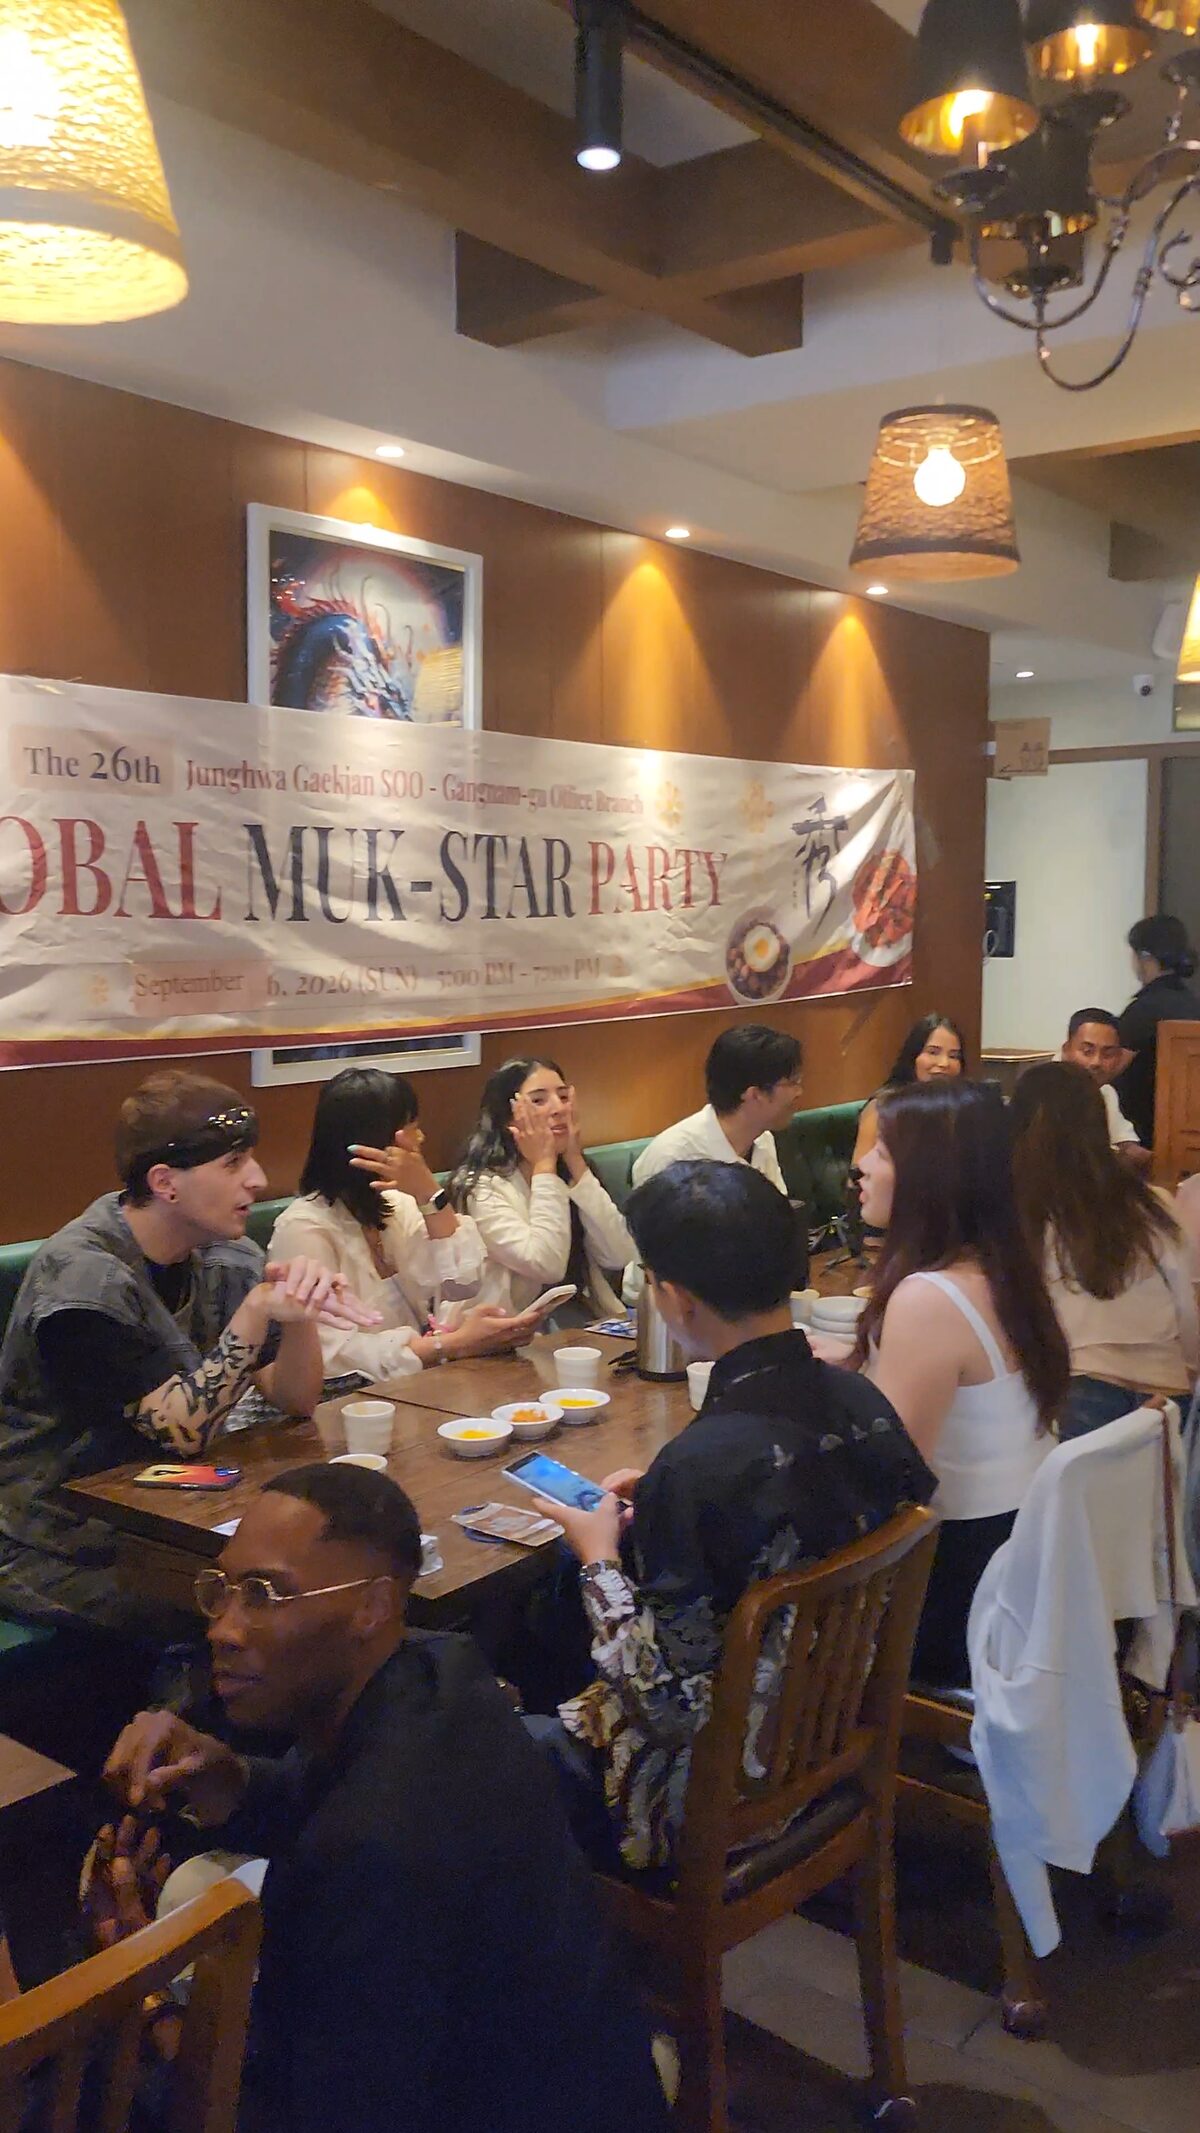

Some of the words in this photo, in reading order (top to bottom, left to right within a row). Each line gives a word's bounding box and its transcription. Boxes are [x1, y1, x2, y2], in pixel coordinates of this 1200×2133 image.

[23, 746, 80, 777] The
[89, 745, 161, 784] 26th
[186, 760, 287, 795] Junghwa
[293, 764, 374, 800] Gaekjan
[380, 769, 424, 799] SOO
[243, 823, 575, 923] MUK-STAR
[587, 841, 728, 916] PARTY
[135, 969, 245, 1002] September
[296, 967, 352, 997] 2026
